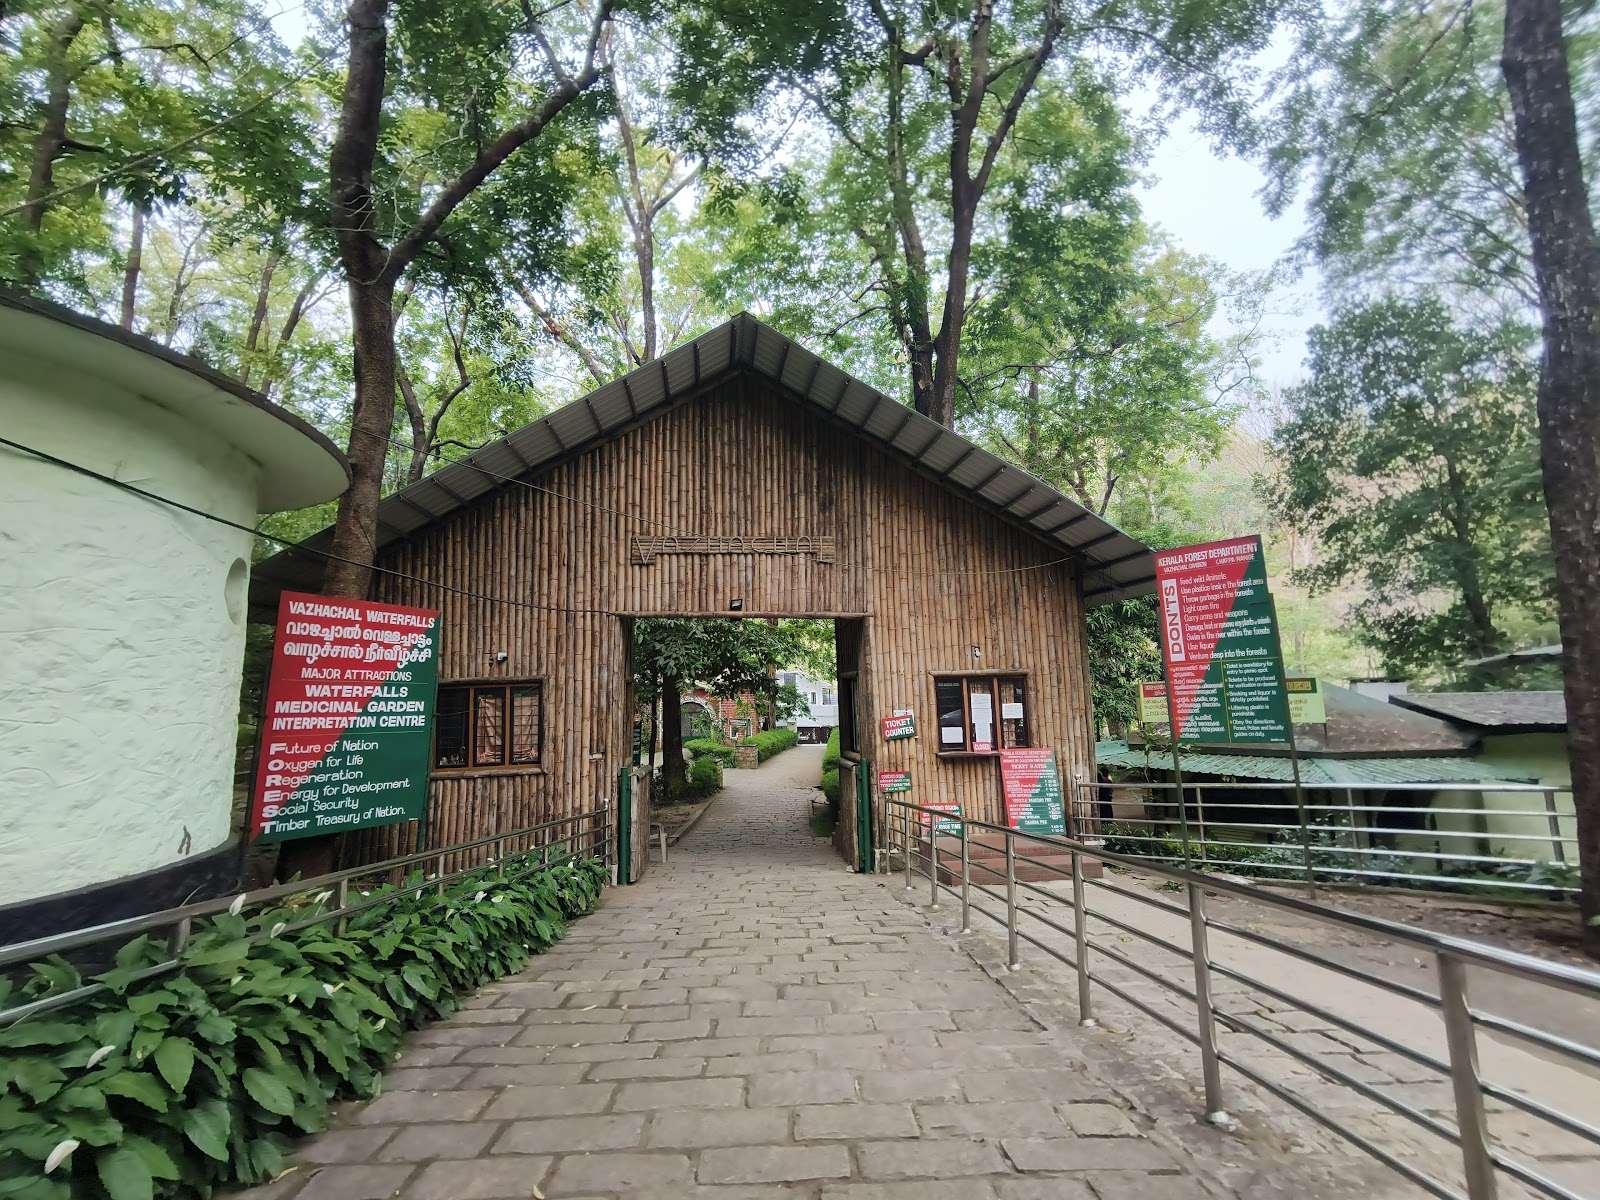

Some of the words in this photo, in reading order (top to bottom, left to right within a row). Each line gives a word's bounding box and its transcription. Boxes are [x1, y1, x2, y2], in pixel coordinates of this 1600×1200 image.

[1158, 555, 1183, 566] KERALA
[1185, 551, 1207, 562] FOREST
[1209, 543, 1257, 558] DEPARTMENT
[1180, 577, 1192, 585] Feed
[1193, 575, 1204, 583] wild
[1192, 584, 1210, 594] plastics
[1228, 579, 1236, 588] the
[1237, 578, 1252, 587] forest
[1182, 595, 1198, 603] Throw
[1199, 593, 1220, 603] garbage
[1225, 590, 1233, 598] the
[1235, 589, 1254, 597] forests
[290, 601, 362, 621] VAZHACHAL
[367, 610, 435, 628] WATERFALLS
[1183, 605, 1196, 613] Light
[1184, 614, 1199, 622] Carry
[1214, 611, 1223, 619] and
[1225, 610, 1248, 618] weapons
[1187, 633, 1200, 641] Swim
[1201, 632, 1205, 640] in
[1216, 630, 1226, 639] river
[1228, 629, 1242, 637] within
[1243, 628, 1252, 636] the
[1253, 627, 1270, 635] forests
[1200, 641, 1215, 649] liquor
[1189, 652, 1209, 660] Venture
[1210, 650, 1223, 659] deep
[1225, 649, 1234, 657] into
[1236, 648, 1245, 656] the
[1246, 647, 1267, 655] forests
[301, 668, 340, 679] MAJOR
[344, 670, 412, 681] ATTRACTIONS
[305, 685, 408, 697] WATERFALLS
[275, 701, 362, 713] MEDICINAL
[368, 701, 424, 712] GARDEN
[272, 716, 376, 730] INTERPRETATION
[380, 715, 425, 727] CENTRE
[885, 718, 910, 728] TICKET
[885, 727, 914, 737] COUNTER
[270, 743, 321, 755] Future
[324, 740, 339, 752] of
[342, 740, 379, 751] Nation
[268, 758, 322, 772] Oxygen
[326, 756, 342, 767] for
[347, 755, 364, 765] Life
[265, 770, 363, 788] Regeneration
[263, 788, 319, 802] Energy
[323, 785, 340, 796] for
[342, 778, 410, 794] Development
[262, 802, 308, 818] Social
[313, 798, 359, 812] Security
[260, 819, 310, 834] Timber
[315, 814, 360, 827] Treasury
[363, 808, 374, 820] of
[375, 805, 406, 818] Nation.
